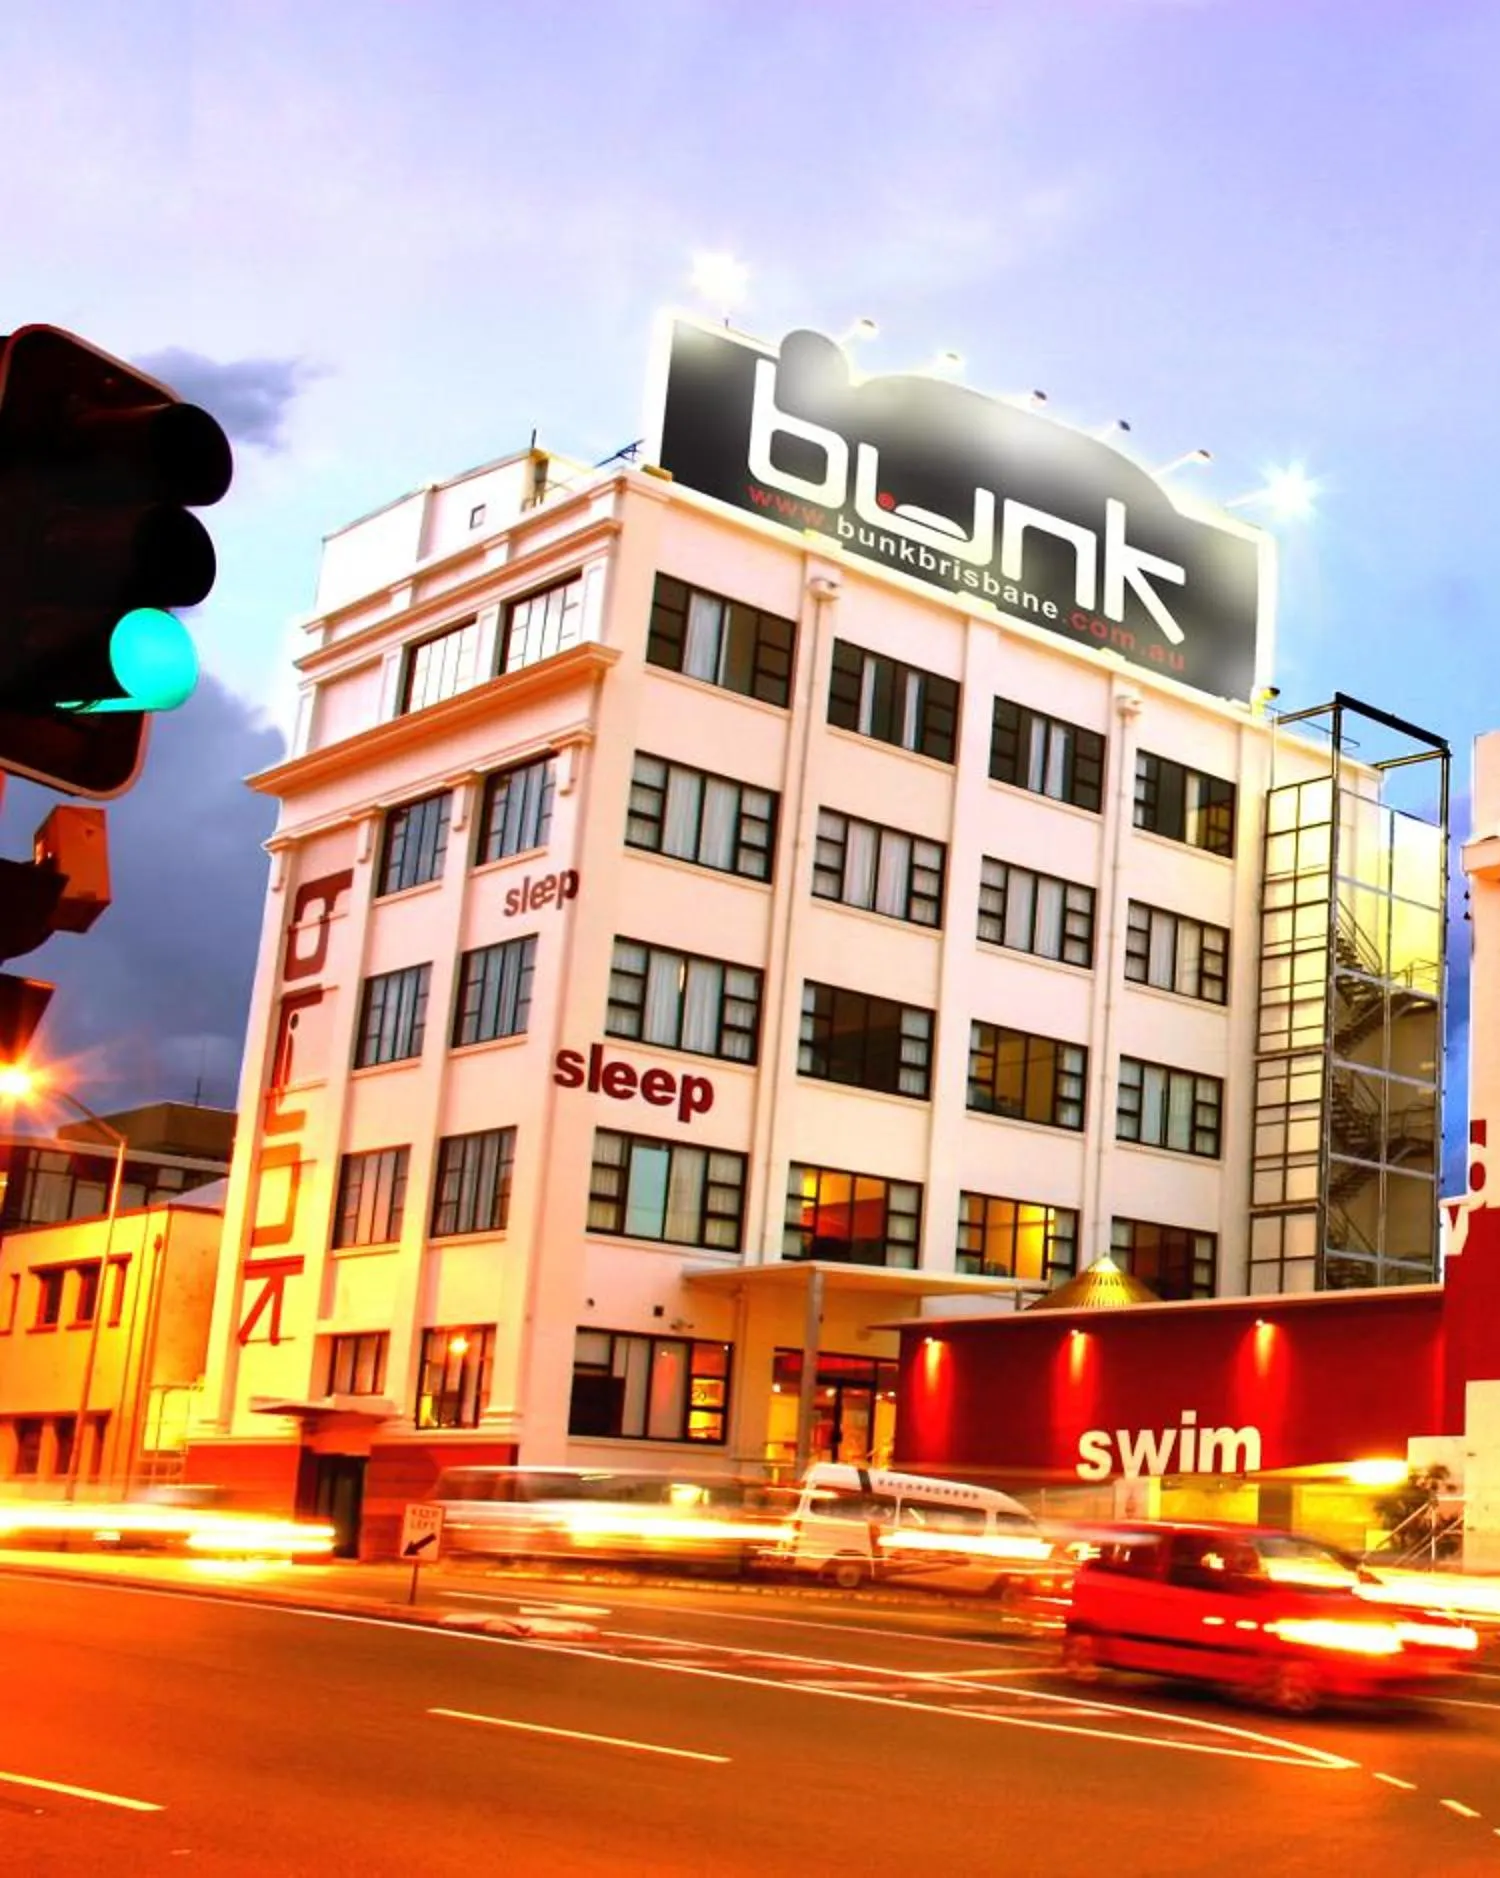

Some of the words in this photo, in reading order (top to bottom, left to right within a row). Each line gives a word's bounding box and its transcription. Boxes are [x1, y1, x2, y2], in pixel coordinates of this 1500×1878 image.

[748, 357, 1186, 645] bunk
[503, 869, 580, 917] sleep
[553, 1043, 715, 1123] sleep
[1076, 1409, 1261, 1482] swim
